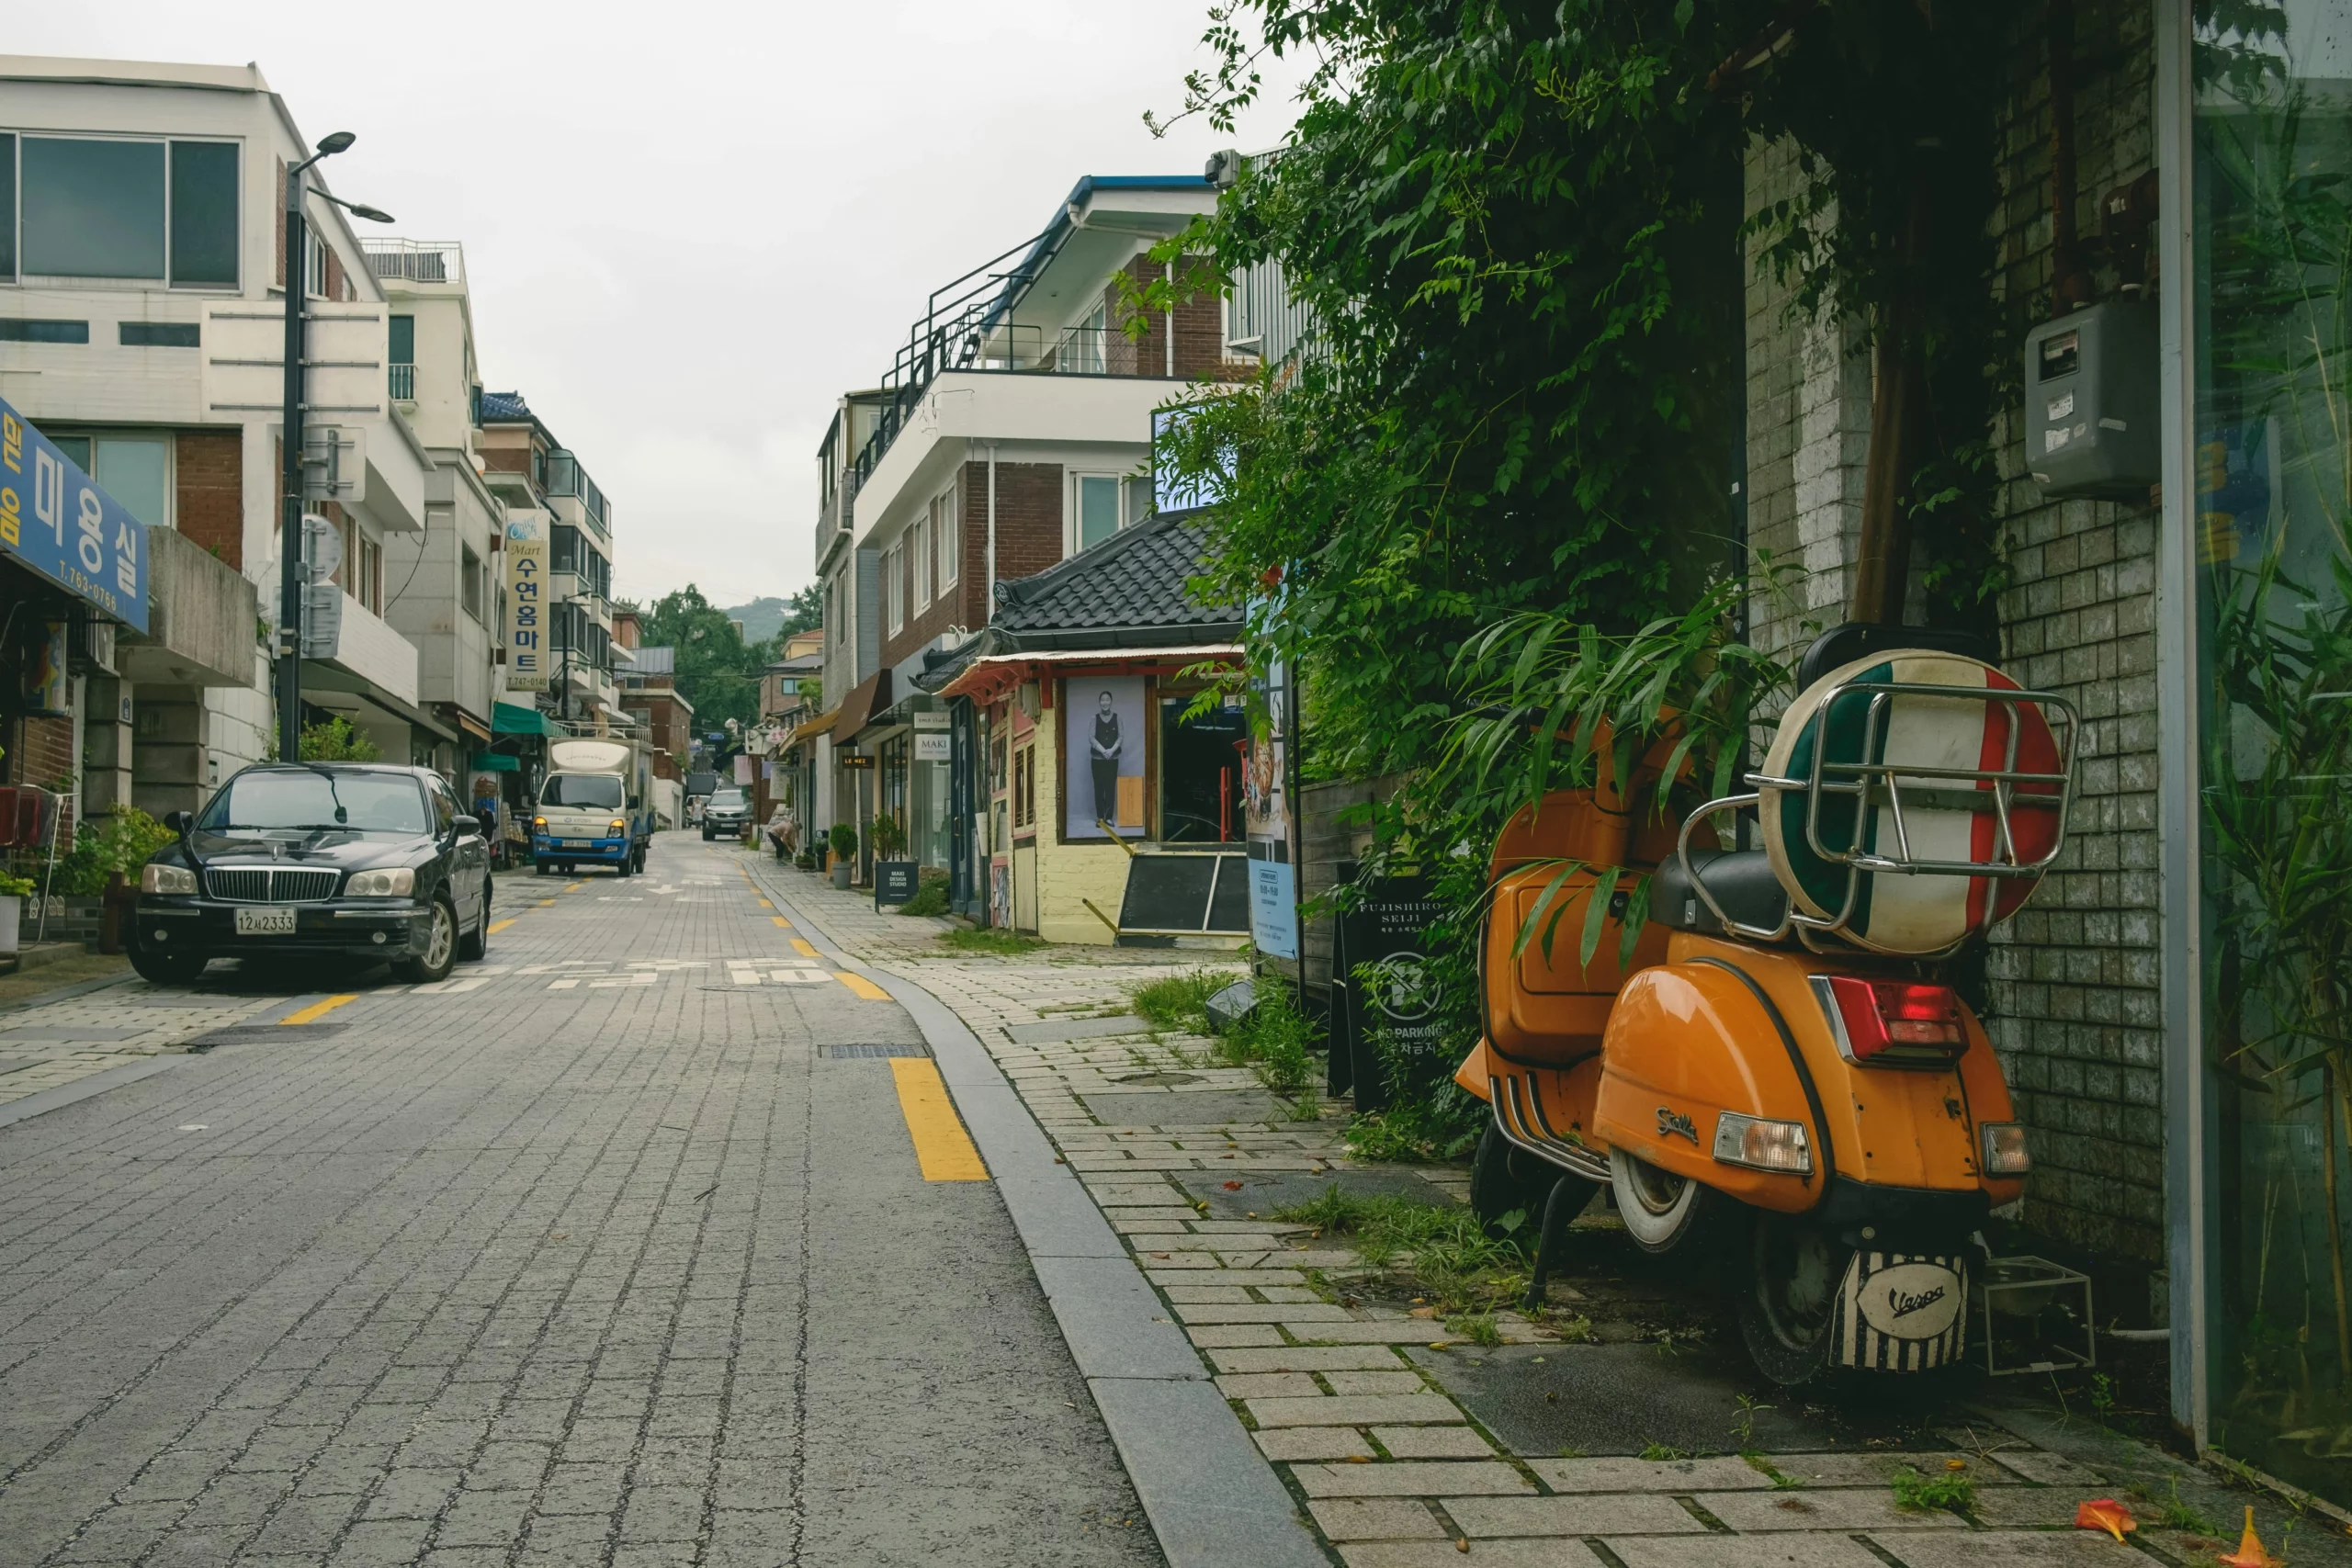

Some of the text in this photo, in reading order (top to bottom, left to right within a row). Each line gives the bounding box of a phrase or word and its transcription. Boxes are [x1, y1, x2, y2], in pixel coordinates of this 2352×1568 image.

[35, 446, 137, 599] 미용실
[511, 545, 540, 556] Mart
[59, 559, 117, 612] T.763-0766
[515, 558, 539, 671] 수연홈마트
[922, 739, 946, 749] MAKI
[1360, 902, 1441, 912] FUJISHIRO
[239, 916, 293, 931] 12서2333
[1381, 914, 1420, 923] SEIJI
[1395, 1026, 1442, 1039] PARKING
[1888, 1285, 1946, 1316] Vespa
